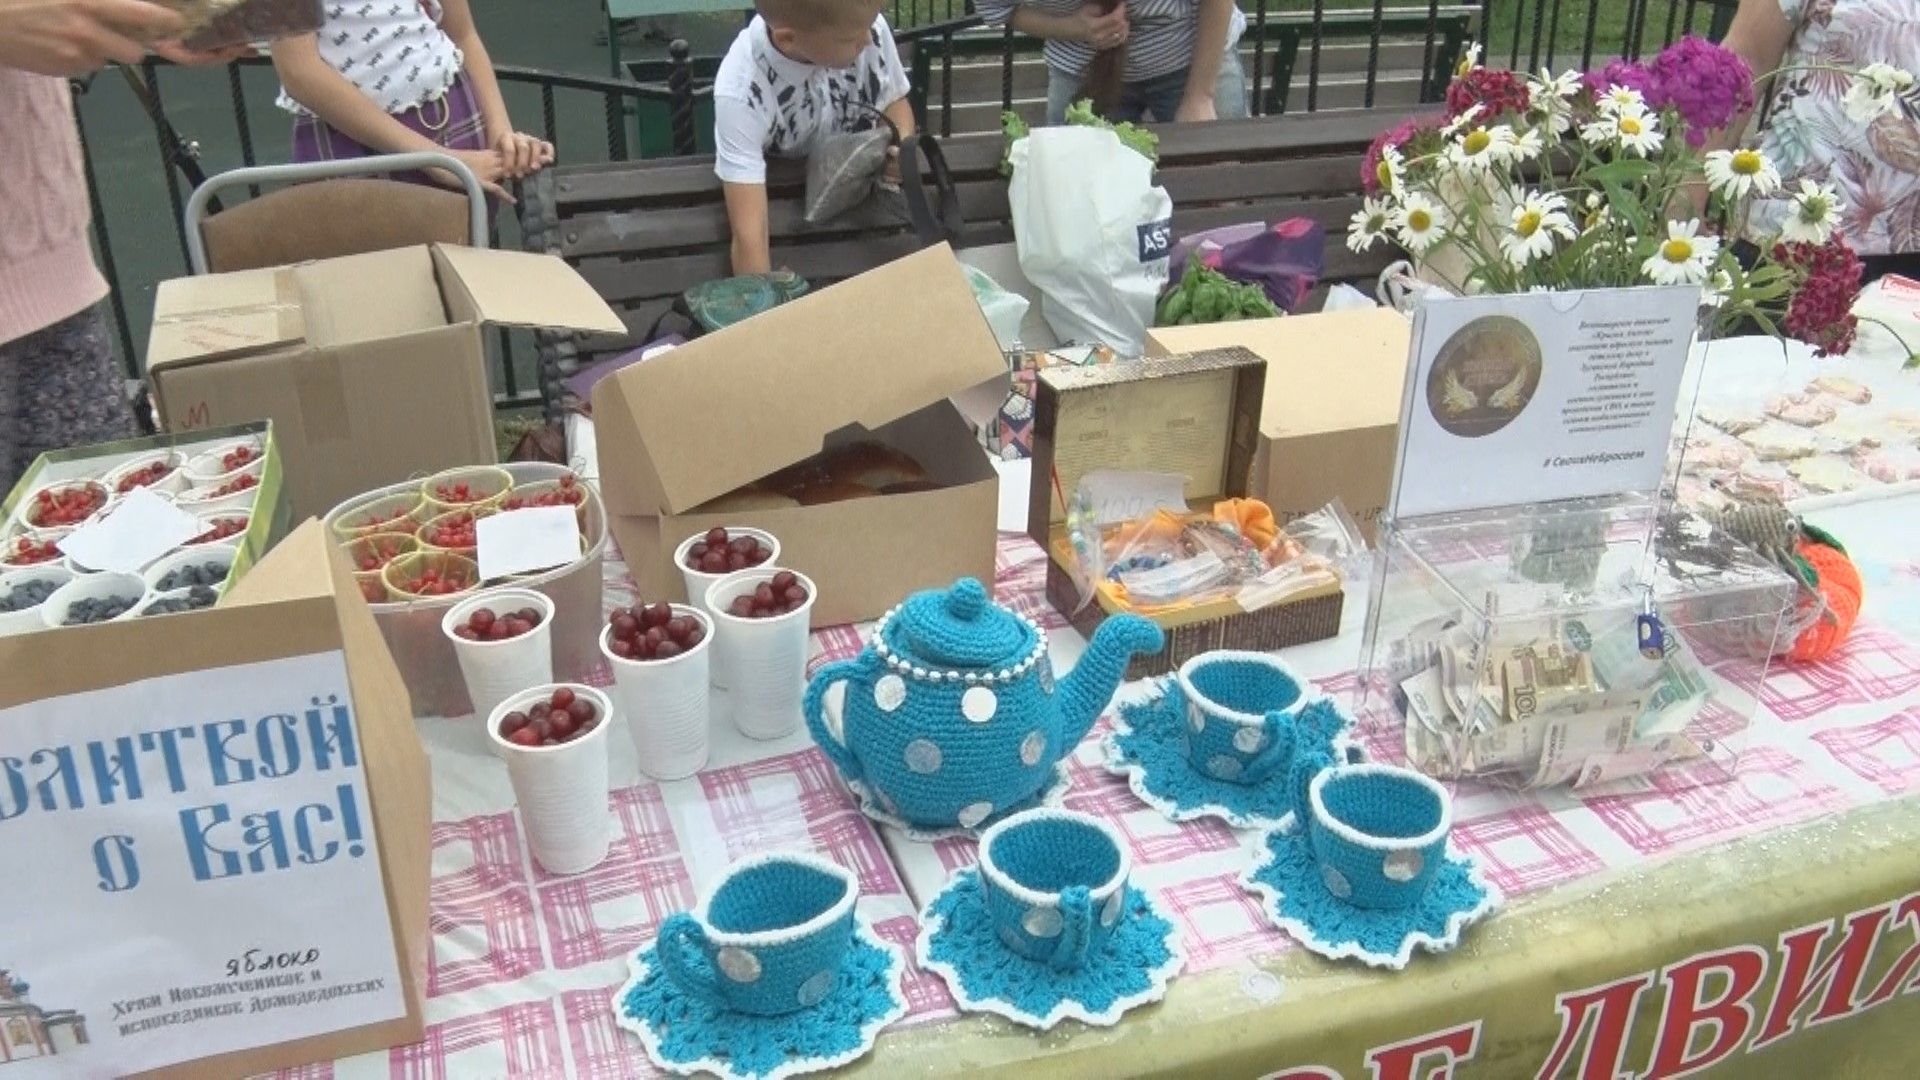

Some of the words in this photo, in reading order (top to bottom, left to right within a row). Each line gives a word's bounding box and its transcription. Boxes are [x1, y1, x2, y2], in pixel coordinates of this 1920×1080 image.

[179, 783, 366, 882] Вас!
[226, 946, 320, 976] яблоко
[111, 993, 162, 1021] Храм
[169, 971, 305, 1006] Новомучеников
[312, 969, 323, 981] и
[118, 1000, 244, 1037] исповедников
[249, 976, 386, 1014] Домодедовских
